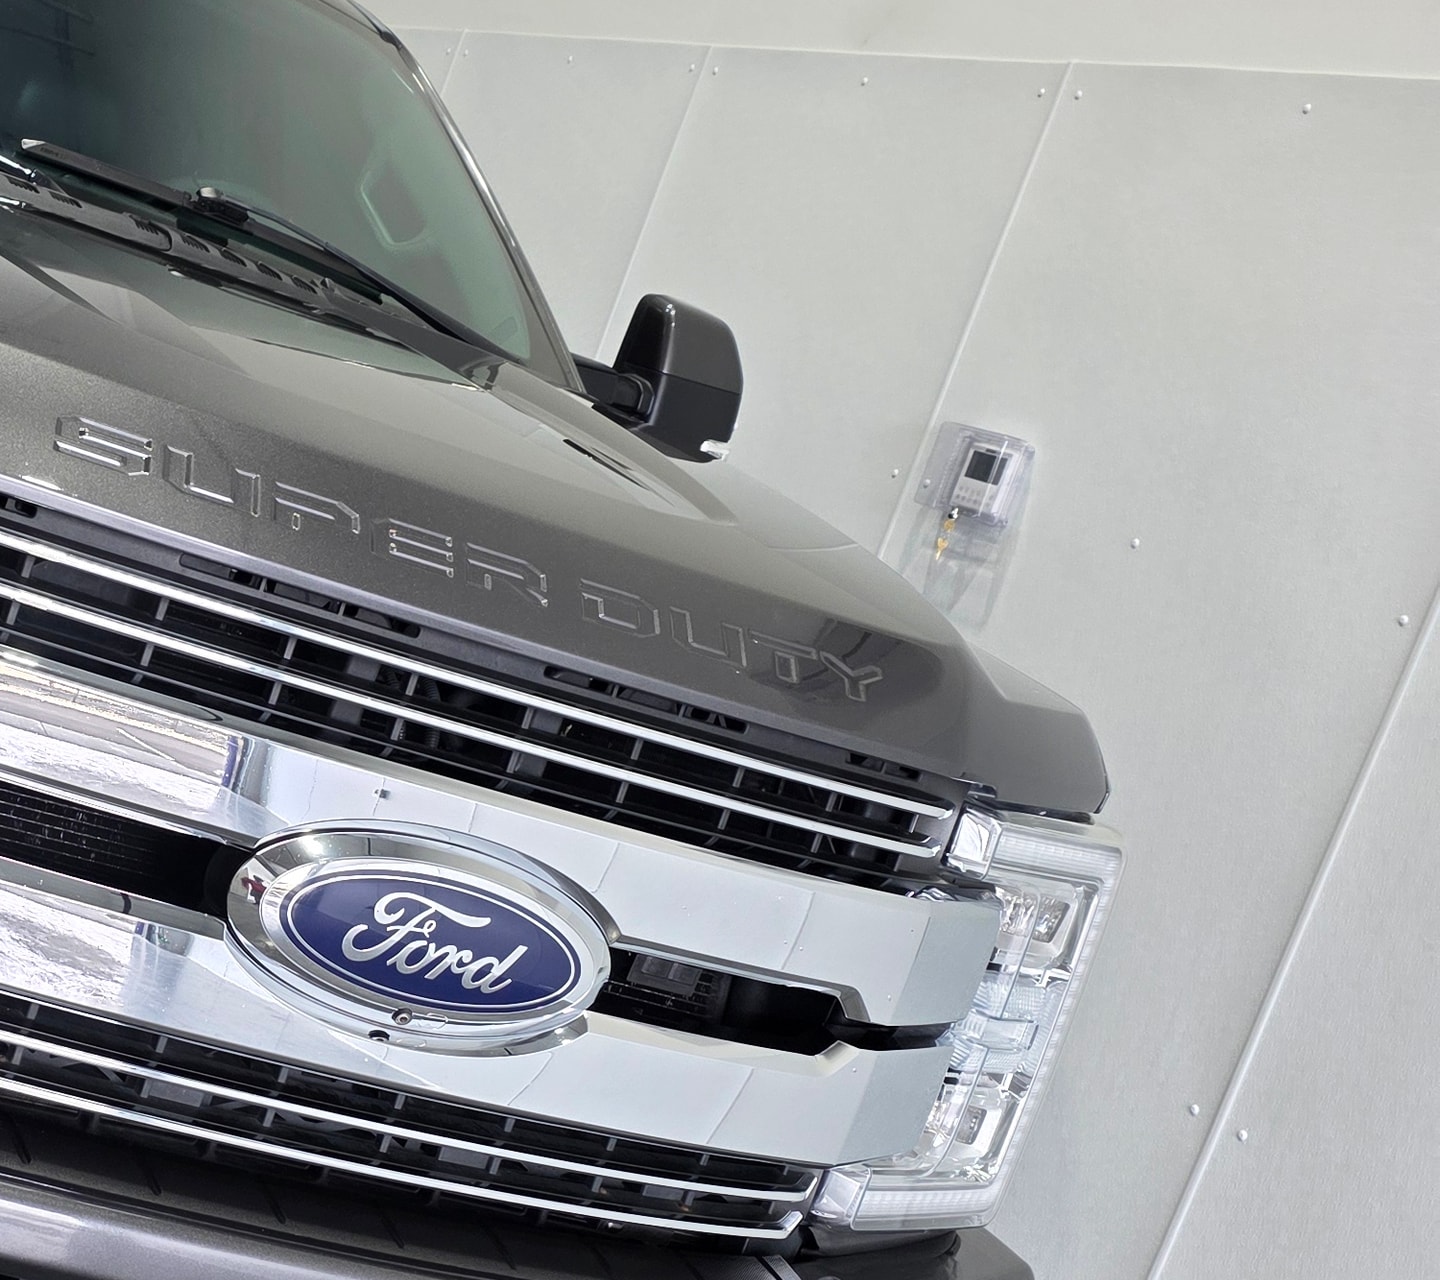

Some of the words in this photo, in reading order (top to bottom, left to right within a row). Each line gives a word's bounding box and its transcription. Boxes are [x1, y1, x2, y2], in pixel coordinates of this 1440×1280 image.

[53, 416, 548, 607] SUPER
[580, 578, 883, 702] DUTY
[342, 892, 528, 994] Ford
